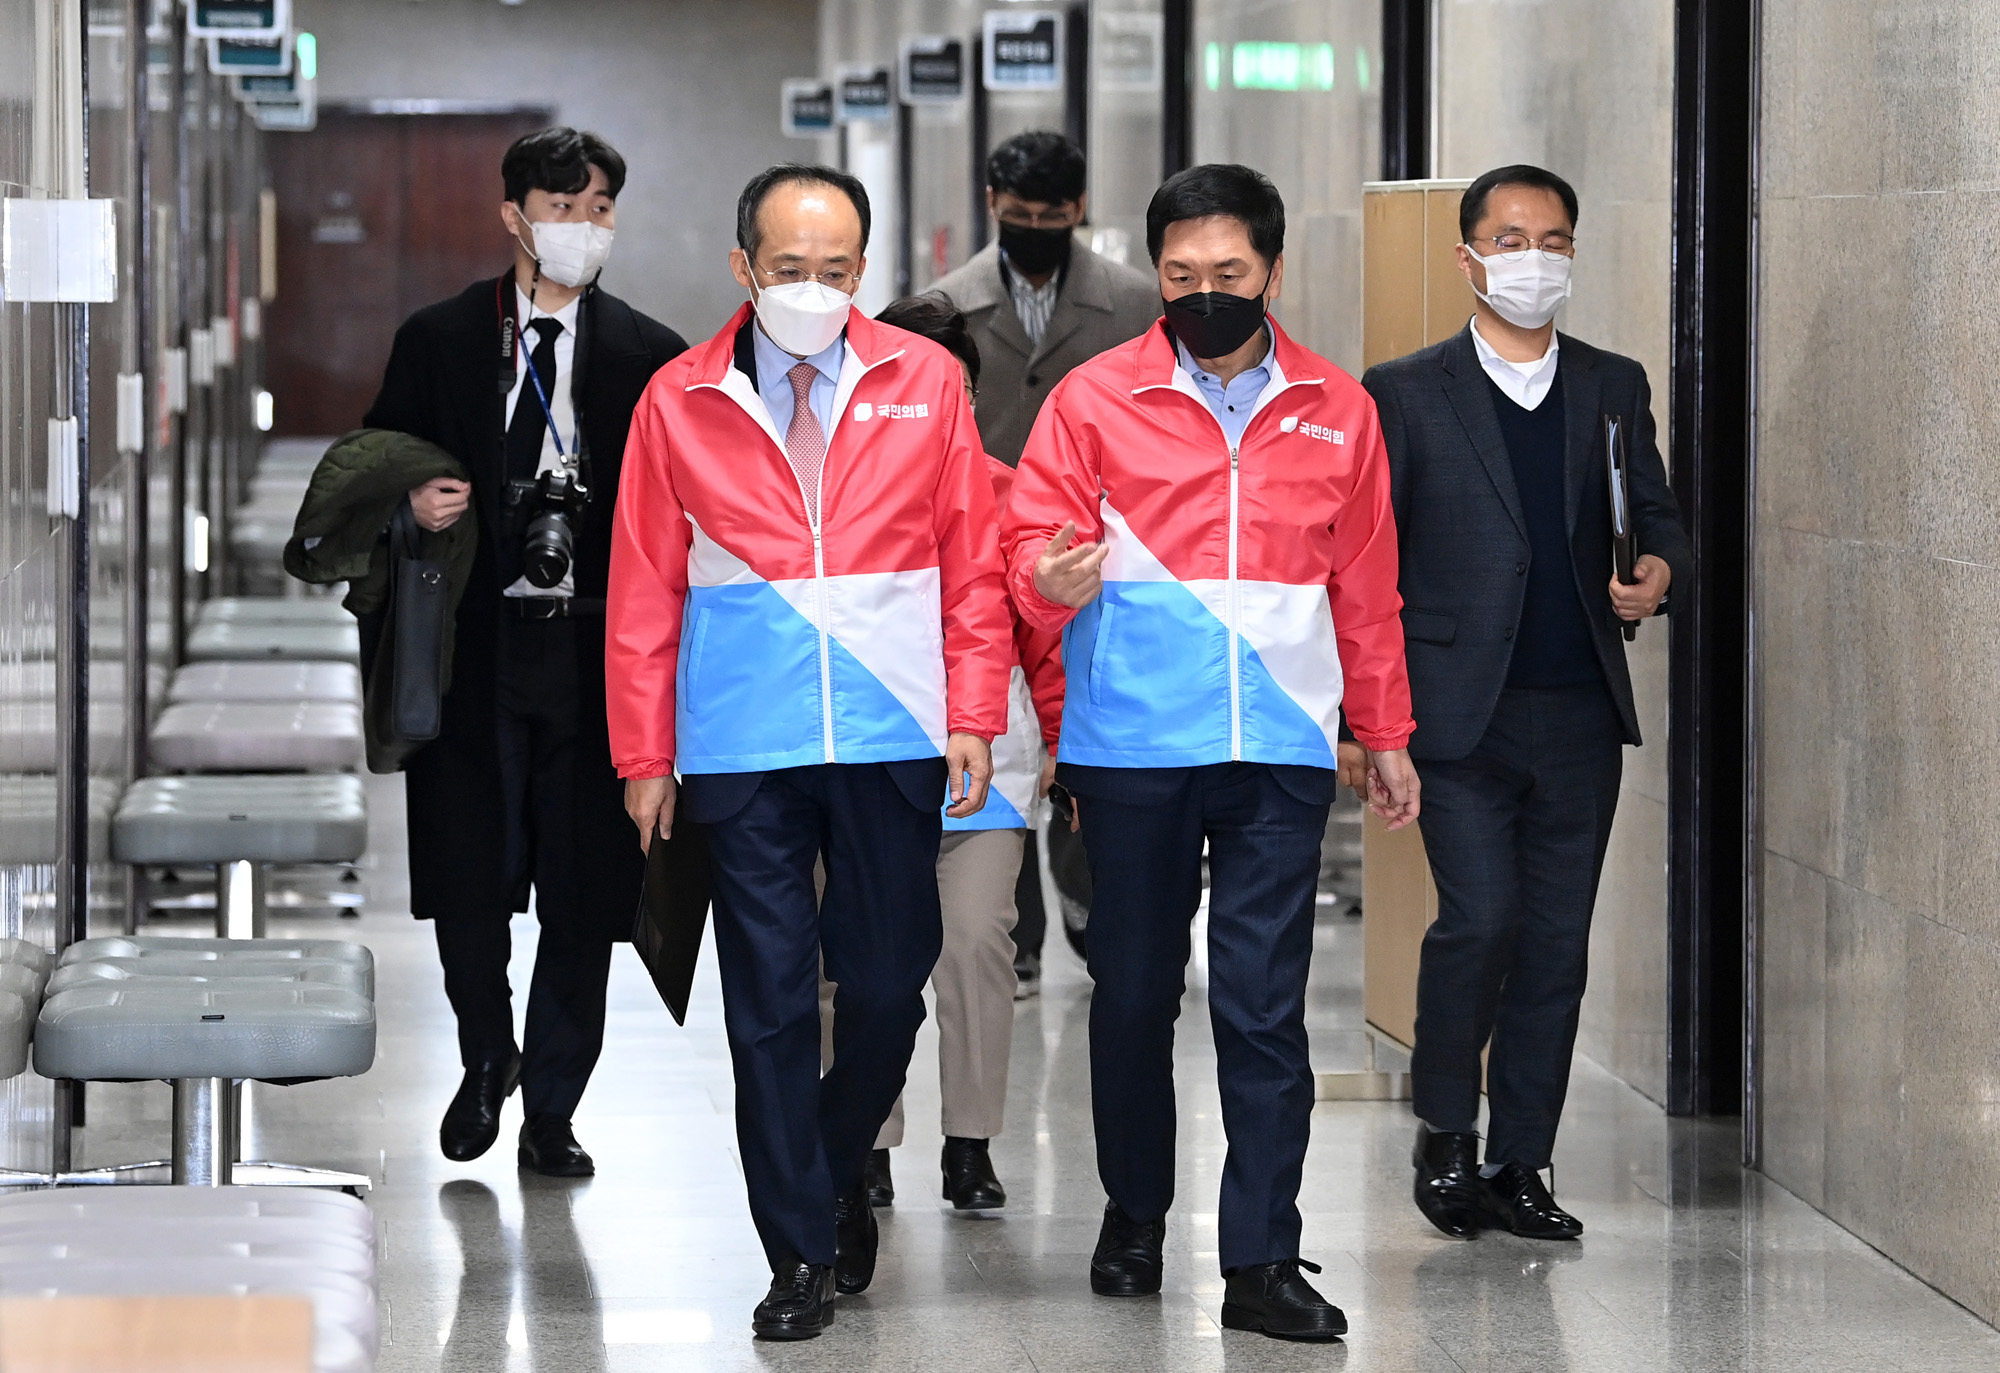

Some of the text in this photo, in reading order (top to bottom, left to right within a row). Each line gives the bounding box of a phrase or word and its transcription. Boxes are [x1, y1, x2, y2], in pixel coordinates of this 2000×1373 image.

[502, 317, 514, 357] Canon
[877, 403, 929, 419] 국민의힘
[1299, 421, 1345, 445] 국민의힘
